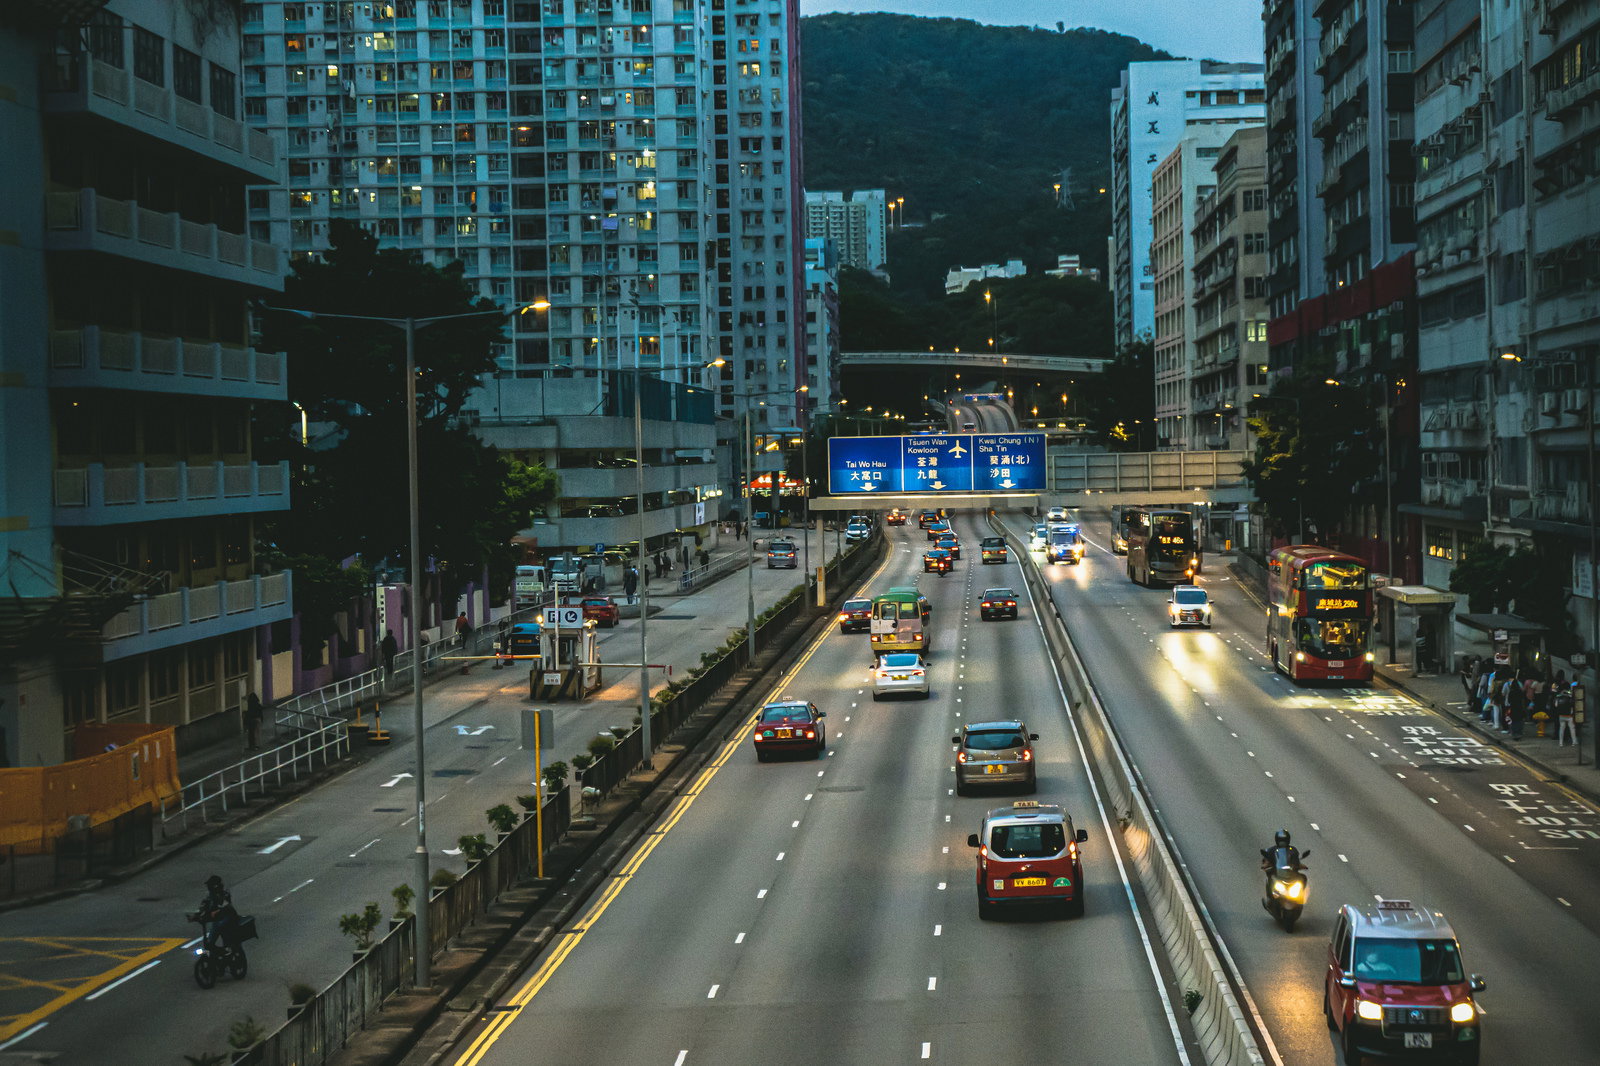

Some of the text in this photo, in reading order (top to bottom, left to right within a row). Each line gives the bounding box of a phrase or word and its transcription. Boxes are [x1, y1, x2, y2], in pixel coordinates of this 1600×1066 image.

[998, 437, 1021, 446] Chung
[918, 457, 938, 467] 荃灣
[851, 471, 882, 481] 大窩口
[918, 470, 938, 479] 九龍
[990, 468, 1010, 478] 沙田
[1402, 736, 1484, 748] 巴士
[1432, 757, 1506, 765] BUS
